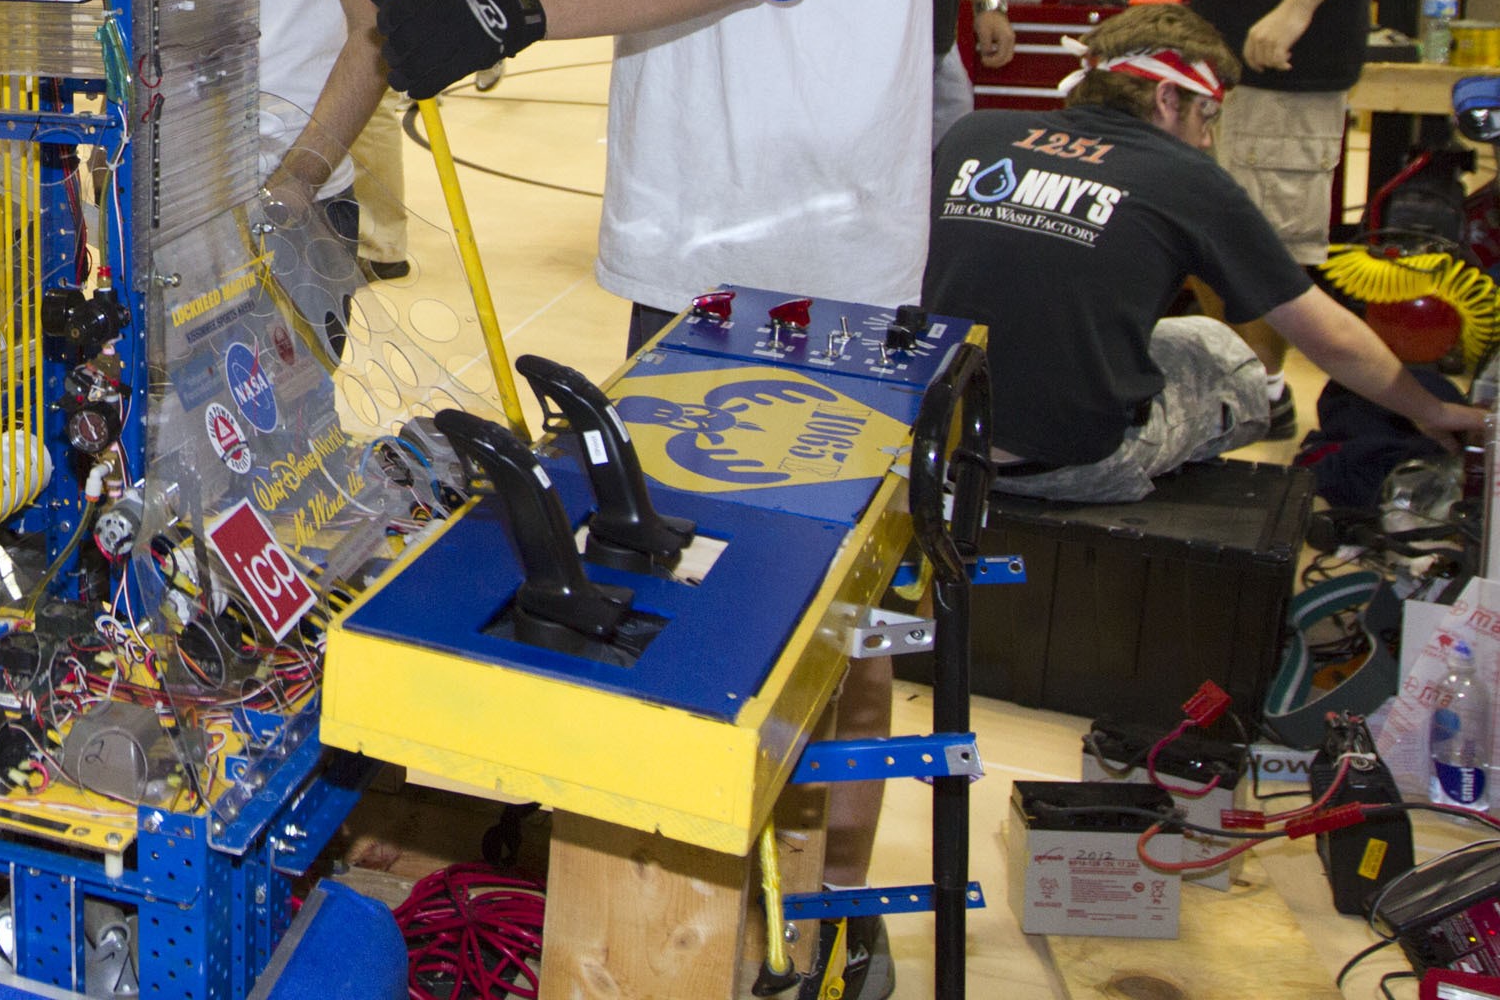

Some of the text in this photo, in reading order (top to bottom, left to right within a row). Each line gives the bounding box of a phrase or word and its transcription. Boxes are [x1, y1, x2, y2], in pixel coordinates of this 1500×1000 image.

[1012, 128, 1115, 164] 1251
[950, 157, 1122, 226] SONNY'S
[943, 202, 1100, 243] THE CAR WASH FACTORY
[172, 271, 257, 328] LOCKHEED MARTIN
[233, 373, 269, 406] NASA
[212, 406, 235, 425] POWER
[313, 424, 347, 464] World
[234, 541, 299, 622] jcp
[1461, 767, 1475, 802] smart
